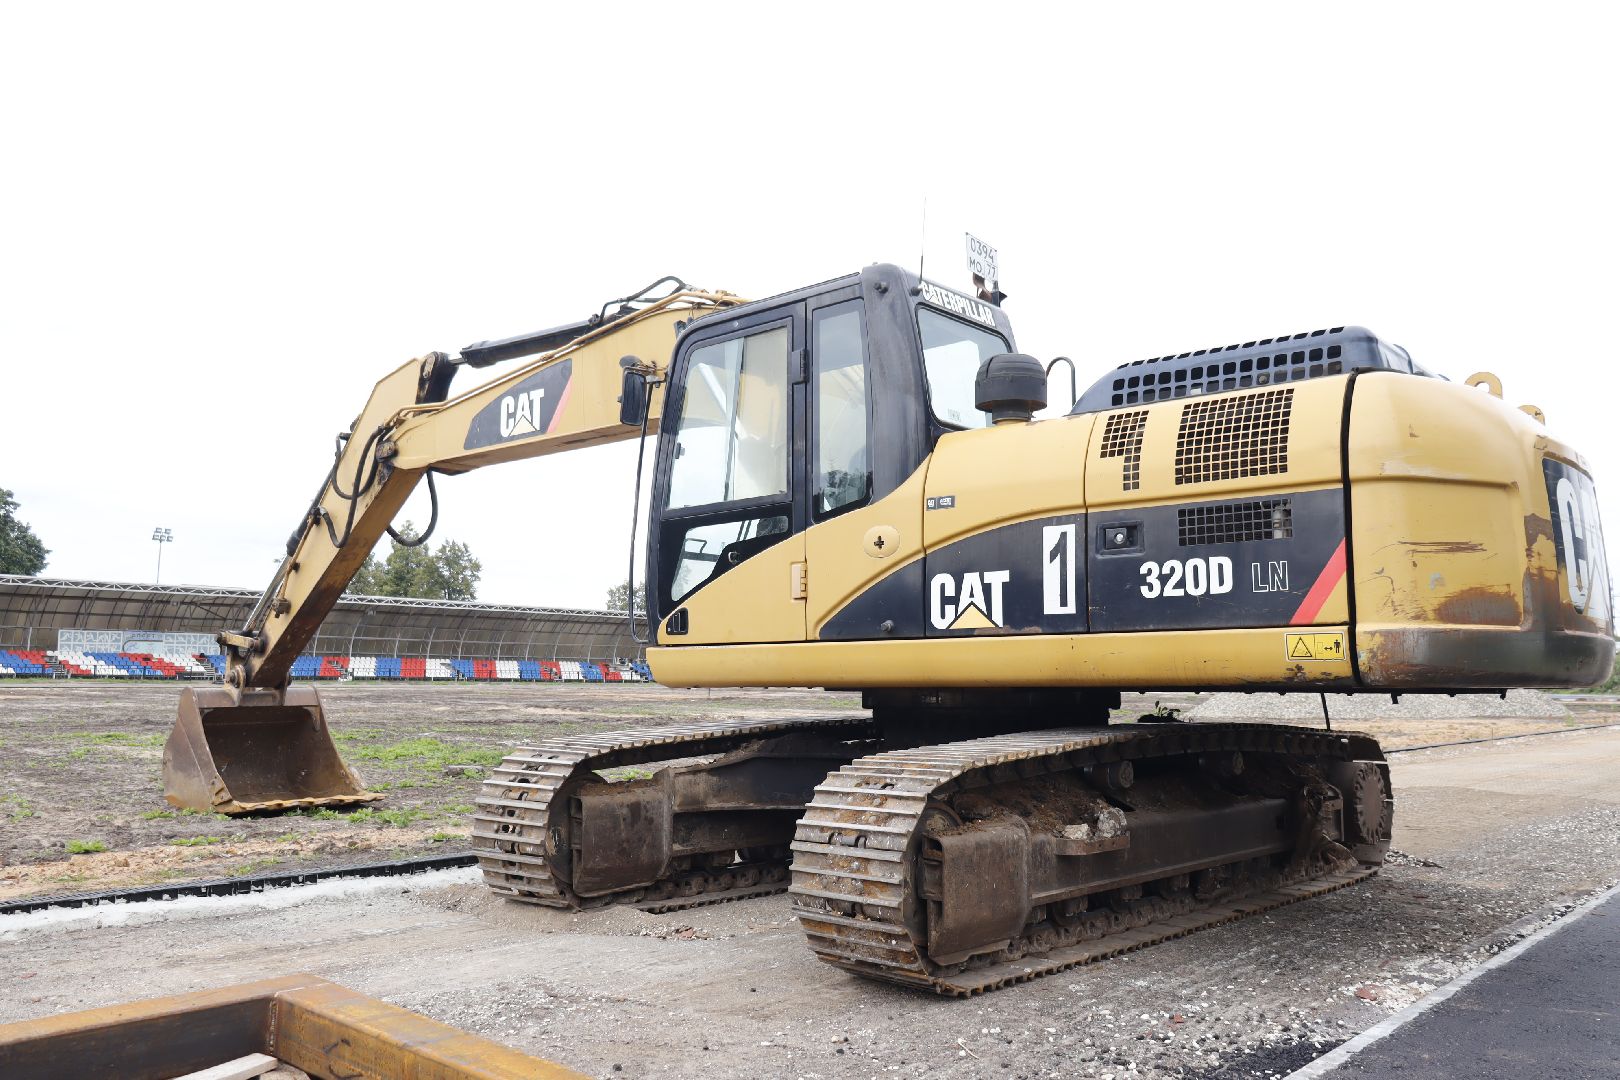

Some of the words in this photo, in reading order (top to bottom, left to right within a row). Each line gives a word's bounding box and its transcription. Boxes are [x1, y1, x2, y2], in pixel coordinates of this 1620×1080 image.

[970, 238, 994, 264] 0394
[921, 281, 996, 327] CATERPILLAR
[500, 388, 545, 438] CAT
[1049, 531, 1068, 608] 1
[1556, 477, 1611, 618] CA
[930, 570, 1010, 630] CAT
[1139, 556, 1233, 598] 320D
[1252, 560, 1289, 593] LN
